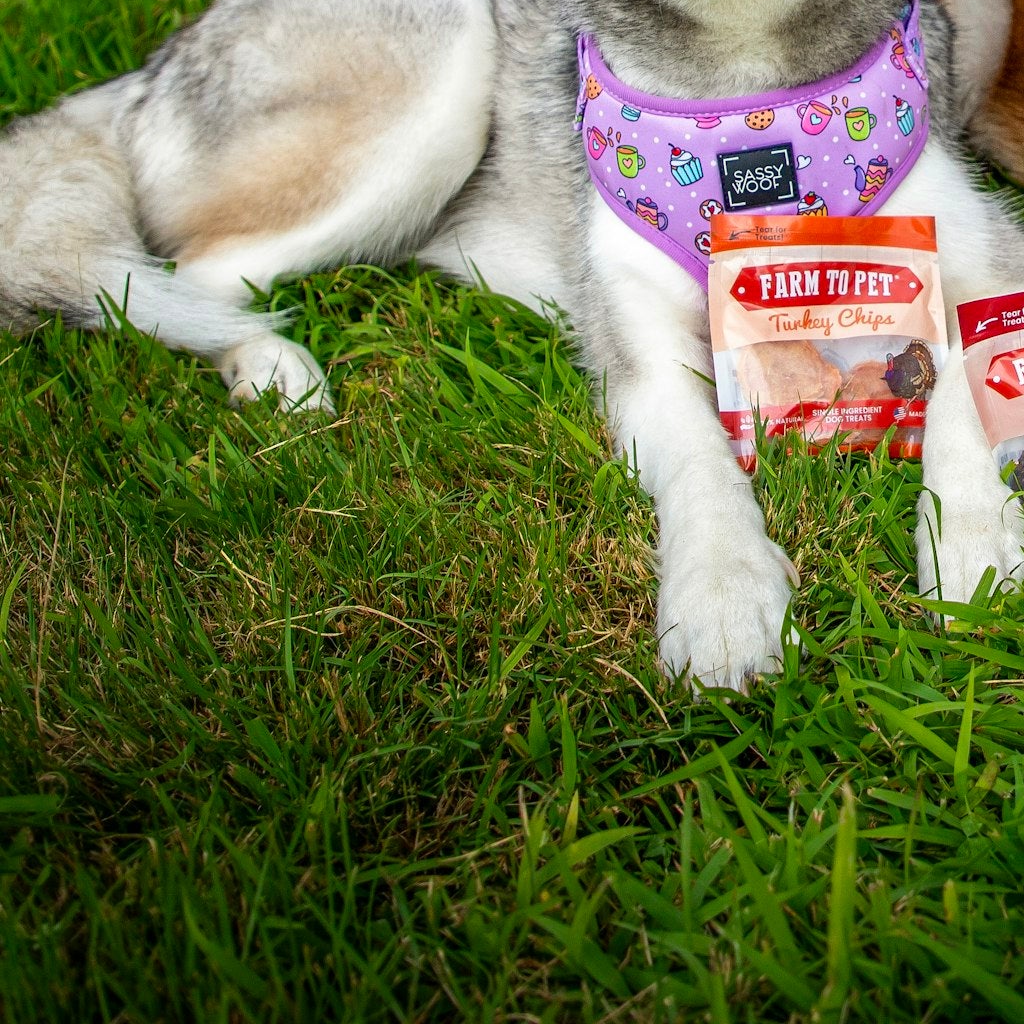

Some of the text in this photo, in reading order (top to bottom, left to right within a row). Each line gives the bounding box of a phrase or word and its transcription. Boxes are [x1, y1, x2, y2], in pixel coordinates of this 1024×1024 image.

[734, 164, 783, 183] SASSY
[732, 176, 782, 194] WOOF
[755, 233, 784, 241] Treats!
[759, 269, 893, 301] FARM TO PET
[1001, 309, 1021, 319] Tear
[768, 307, 895, 336] Turkey Chips
[841, 406, 882, 415] INGREDIENT
[775, 416, 804, 424] NATURA
[826, 414, 872, 424] DOG TREATS
